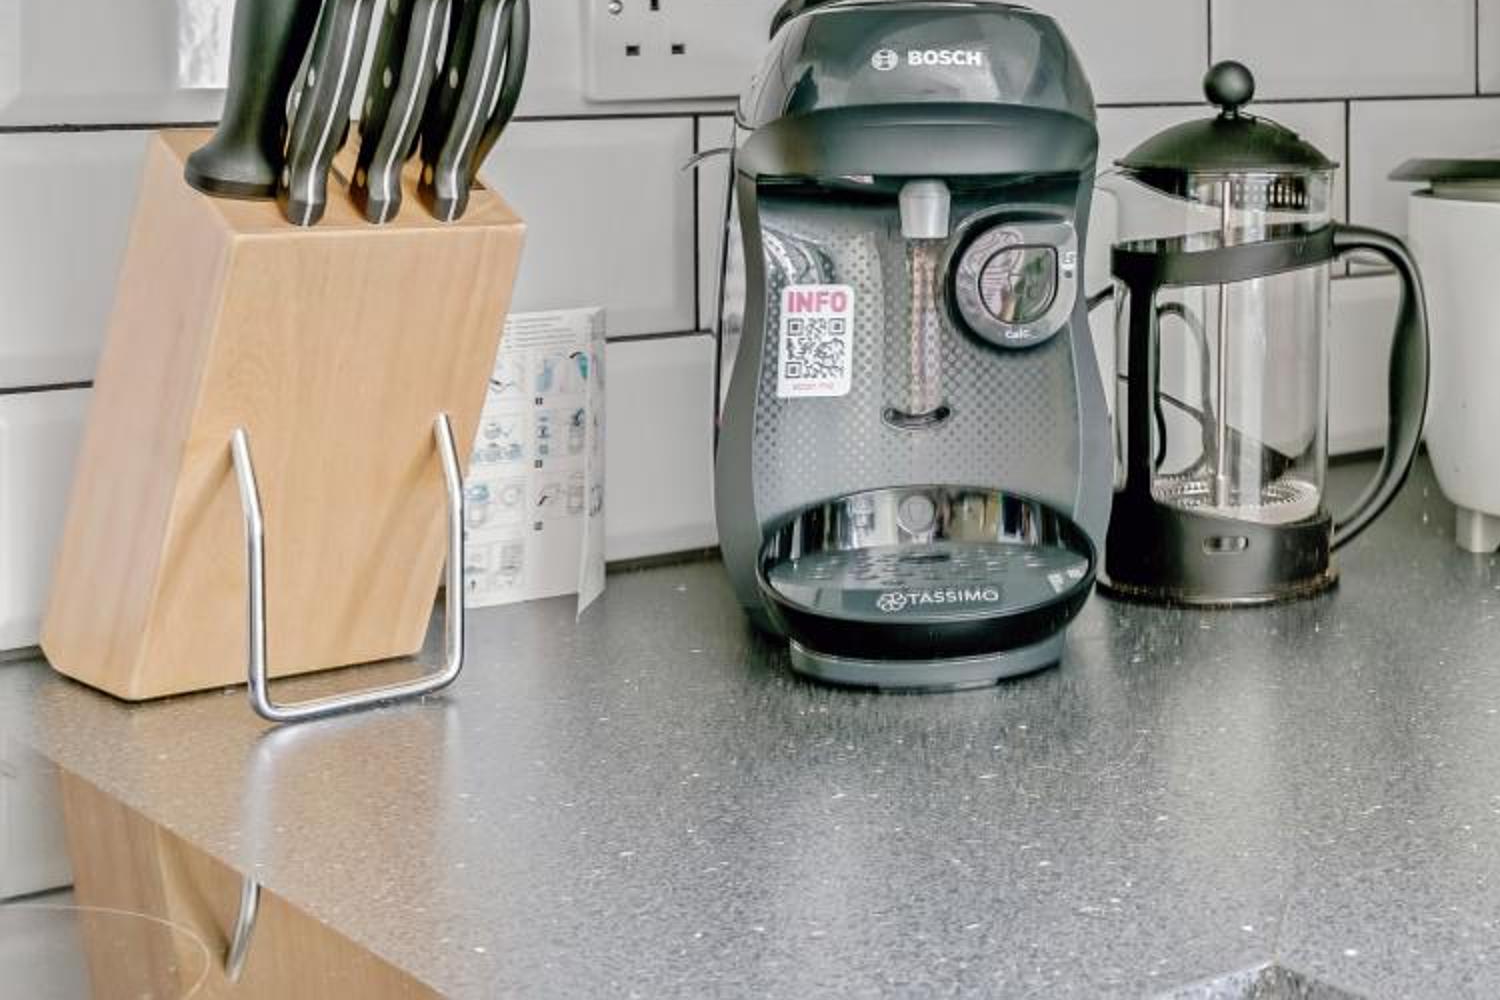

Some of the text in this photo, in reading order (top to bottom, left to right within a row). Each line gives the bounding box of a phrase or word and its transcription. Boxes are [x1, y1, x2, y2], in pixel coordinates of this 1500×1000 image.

[906, 50, 983, 66] BOSCH
[787, 291, 847, 313] INFO
[906, 588, 999, 605] TASSIMO
